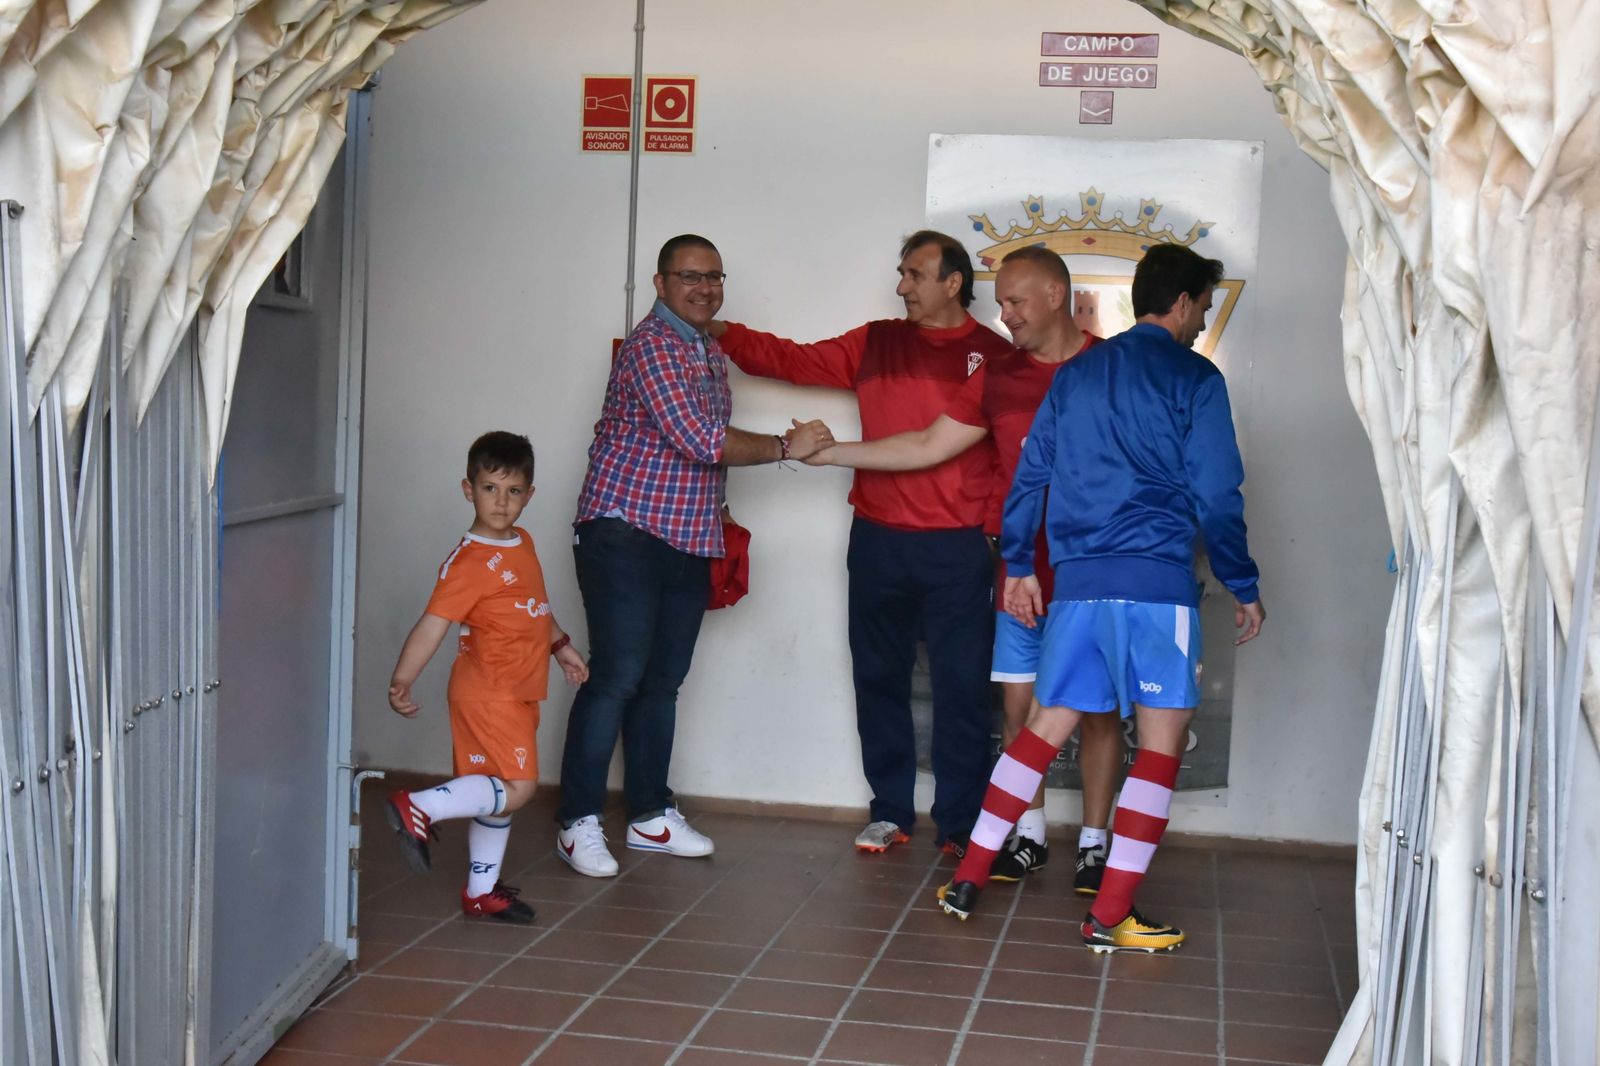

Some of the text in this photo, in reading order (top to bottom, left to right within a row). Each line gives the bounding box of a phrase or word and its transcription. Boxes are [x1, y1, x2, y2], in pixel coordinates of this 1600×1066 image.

[1063, 35, 1135, 52] CAMPO
[1047, 65, 1149, 82] DE JUEGO
[584, 132, 628, 140] AVISADOR
[649, 134, 688, 142] PULSADOR
[586, 141, 625, 150] SONORO
[1139, 680, 1162, 694] 1909
[468, 754, 486, 764] 1909
